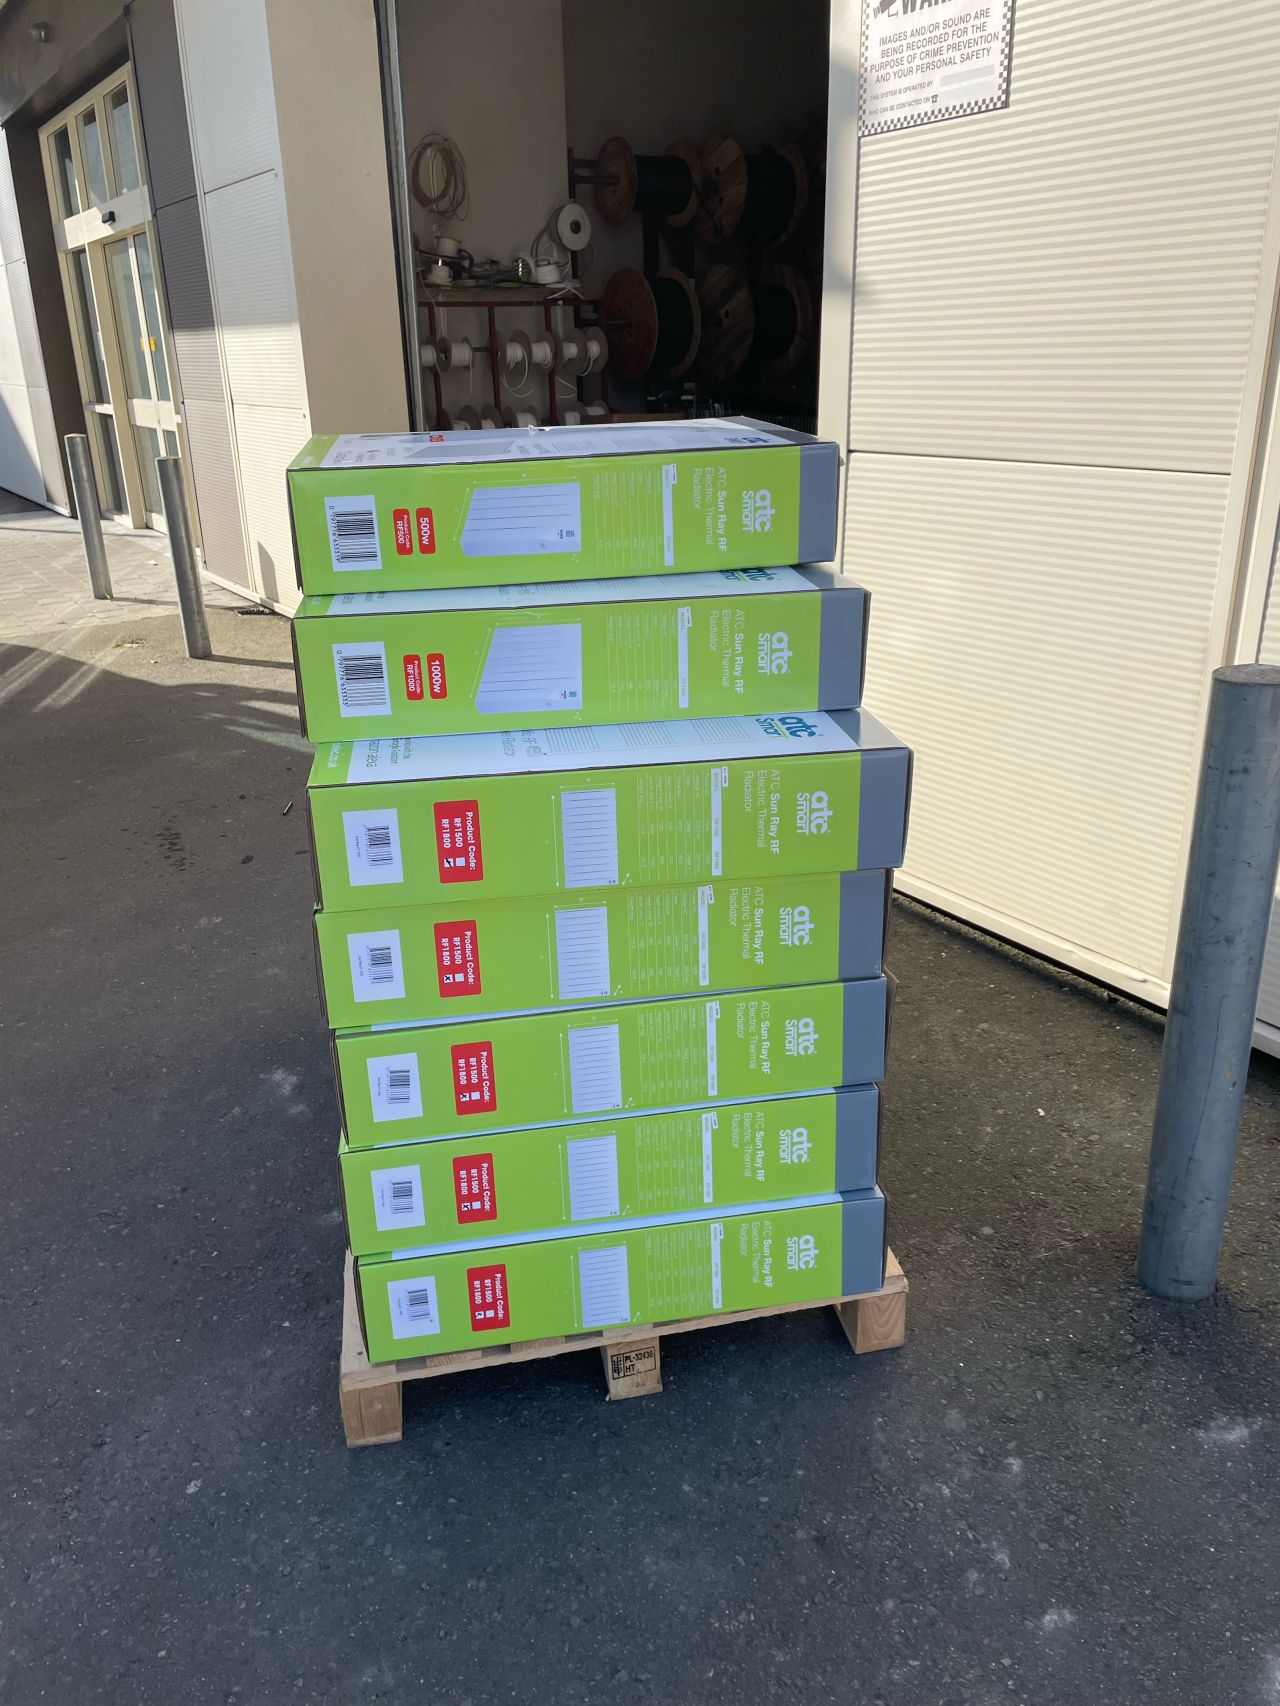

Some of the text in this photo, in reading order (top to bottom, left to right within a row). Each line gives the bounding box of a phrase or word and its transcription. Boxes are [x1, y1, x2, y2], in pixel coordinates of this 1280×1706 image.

[879, 8, 991, 46] IMAGES AND/OR SOUND ARE
[881, 21, 987, 59] BEING RECORDED FOR THE
[870, 31, 1000, 74] PURPOSE OF CRIME PREVENTION
[875, 47, 992, 84] AND YOUR PERSONAL SAFETY
[880, 90, 897, 99] SYSTEM
[903, 82, 927, 94] OPERATED
[896, 98, 923, 110] CONTACTED
[716, 466, 727, 552] ATC Sun Ray RF
[742, 490, 754, 533] Smart
[755, 489, 776, 532] atc
[396, 520, 405, 544] RF500
[420, 517, 431, 545] 500w
[709, 610, 719, 652] Radiator
[722, 609, 731, 687] Electric Thermal
[733, 609, 744, 694] ATC Sun Ray RF
[758, 632, 771, 675] Smart
[771, 631, 793, 674] atc
[406, 664, 416, 692] RF1000
[431, 660, 442, 693] 1000w
[778, 716, 818, 738] atc
[744, 771, 754, 812] Radiator
[757, 770, 767, 847] Electric Thermal
[768, 769, 781, 855] ATC Sun Ray RF
[796, 792, 809, 835] Smart
[811, 790, 833, 834] atc
[441, 818, 451, 849] RF1800
[453, 817, 463, 848] RF1500
[465, 811, 477, 870] Product Code:
[729, 888, 739, 926] Radiator
[742, 887, 751, 959] Electric Thermal
[752, 887, 764, 965] ATC Sun Ray RF
[793, 905, 815, 946] atc
[779, 907, 792, 947] Smart
[441, 938, 451, 966] RF1800
[453, 936, 462, 965] RF1500
[464, 930, 475, 985] Product Code:
[736, 1002, 746, 1039] Radiator
[749, 1001, 758, 1069] Electric Thermal
[759, 1000, 770, 1074] ATC Sun Ray RF
[785, 1019, 797, 1056] Smart
[798, 1017, 819, 1055] atc
[458, 1058, 467, 1085] RF1800
[469, 1057, 478, 1084] RF1500
[480, 1051, 491, 1103] Product Code:
[754, 1112, 765, 1182] ATC Sun Ray RF
[779, 1129, 791, 1164] Smart
[792, 1127, 813, 1163] atc
[459, 1170, 468, 1195] RF1800
[470, 1168, 479, 1194] RF1500
[481, 1163, 491, 1212] Product Code:
[762, 1220, 773, 1288] ATC Sun Ray RF
[786, 1236, 799, 1270] Smart
[799, 1234, 819, 1269] atc
[473, 1280, 482, 1304] RF1800
[484, 1279, 493, 1303] RF1500
[494, 1273, 504, 1320] Product Code:
[625, 1364, 635, 1373] HT
